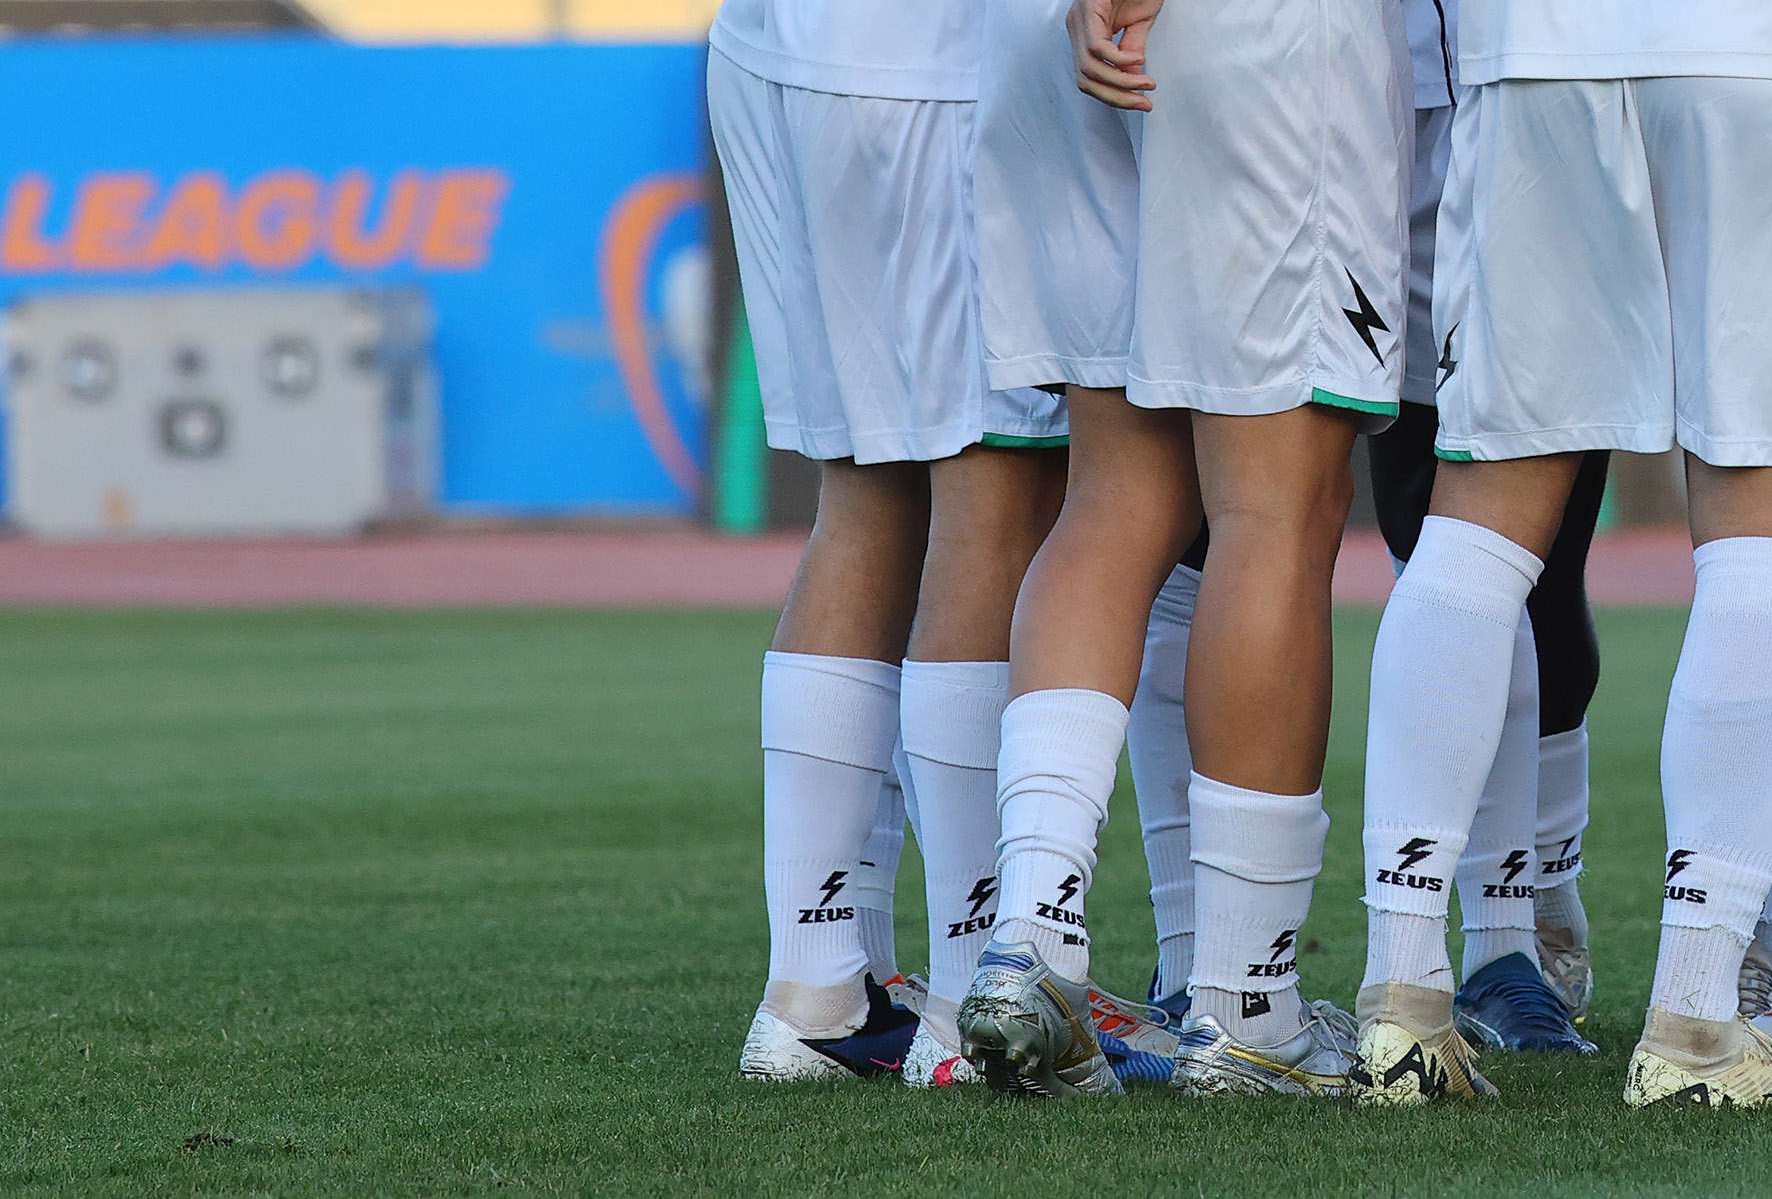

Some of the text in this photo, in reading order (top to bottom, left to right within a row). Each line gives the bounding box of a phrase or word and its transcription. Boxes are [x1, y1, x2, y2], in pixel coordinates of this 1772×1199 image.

[2, 167, 510, 272] LEAGUE
[1376, 868, 1443, 892] ZEUS
[1482, 884, 1535, 899] ZEUS
[1664, 885, 1707, 904] EUS
[798, 906, 855, 924] ZEUS
[948, 912, 996, 939] ZEU
[1036, 902, 1085, 929] ZEUS
